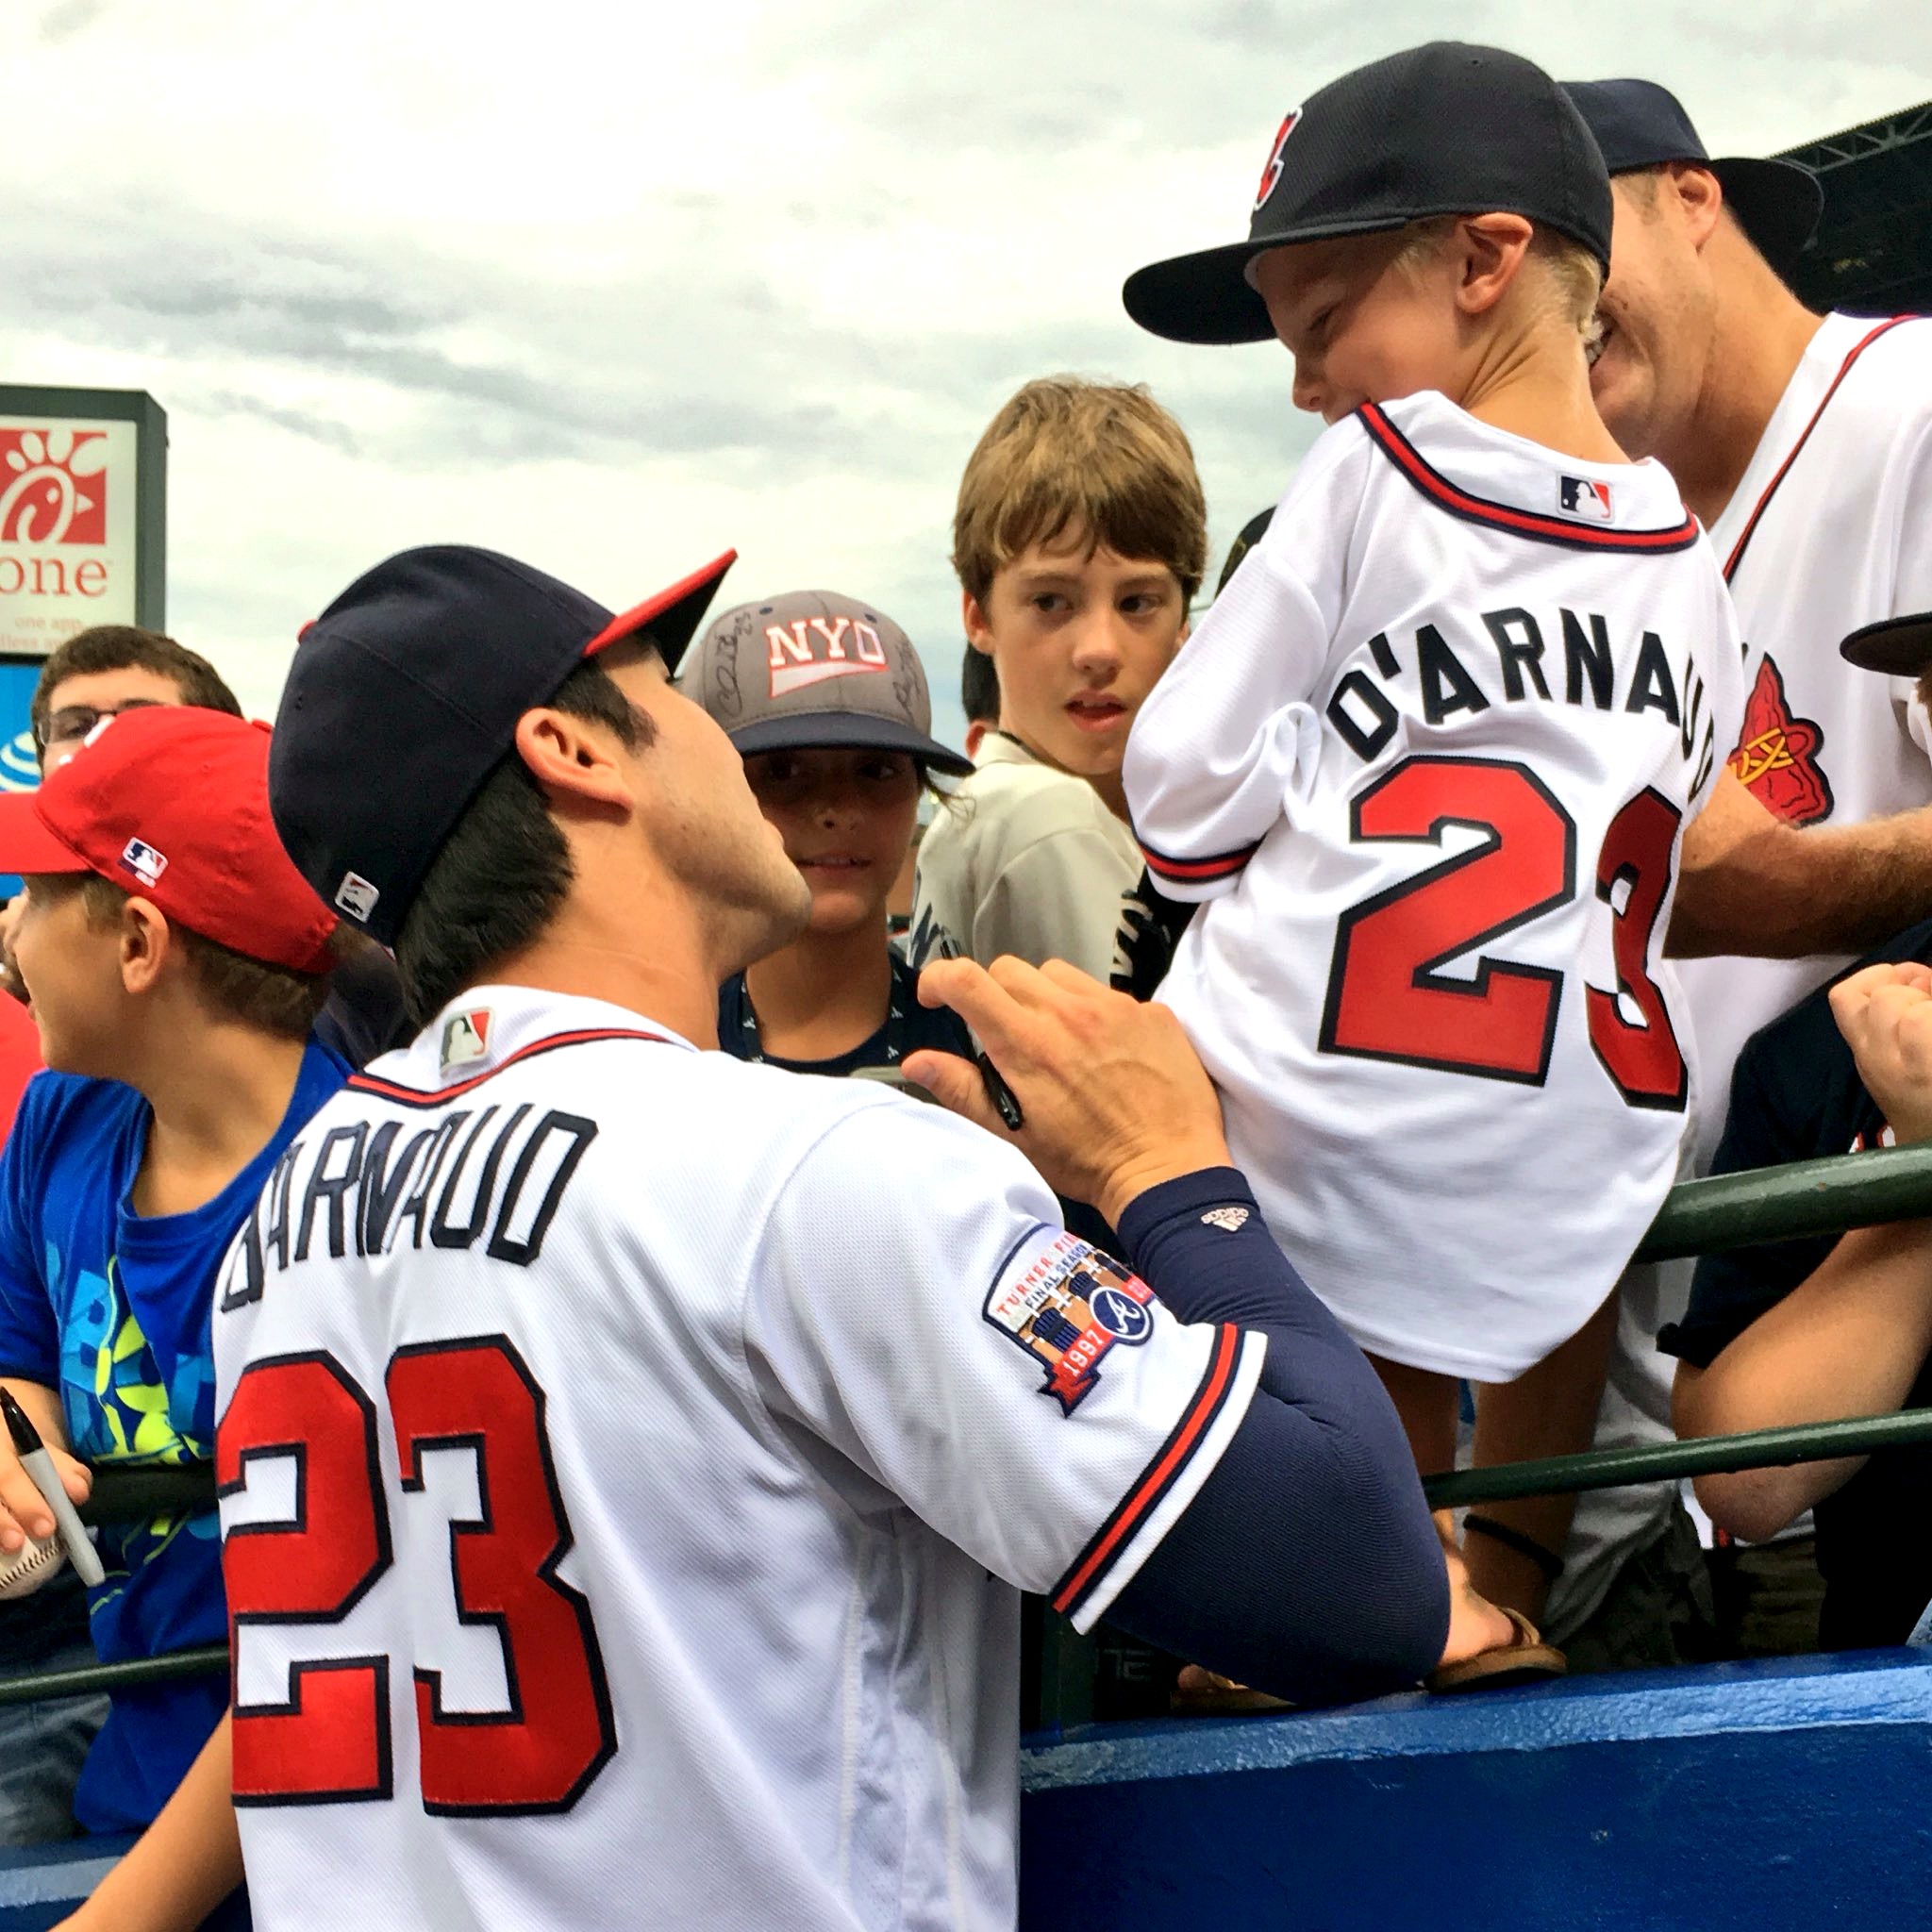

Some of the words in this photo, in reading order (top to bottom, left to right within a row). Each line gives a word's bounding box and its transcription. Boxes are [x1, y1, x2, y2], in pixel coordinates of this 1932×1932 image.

[1318, 754, 1689, 1112] 23
[996, 1256, 1054, 1316] TURNER
[1024, 1275, 1061, 1309] FINAL
[1062, 1329, 1104, 1377] 1997
[215, 1332, 619, 1817] 23
